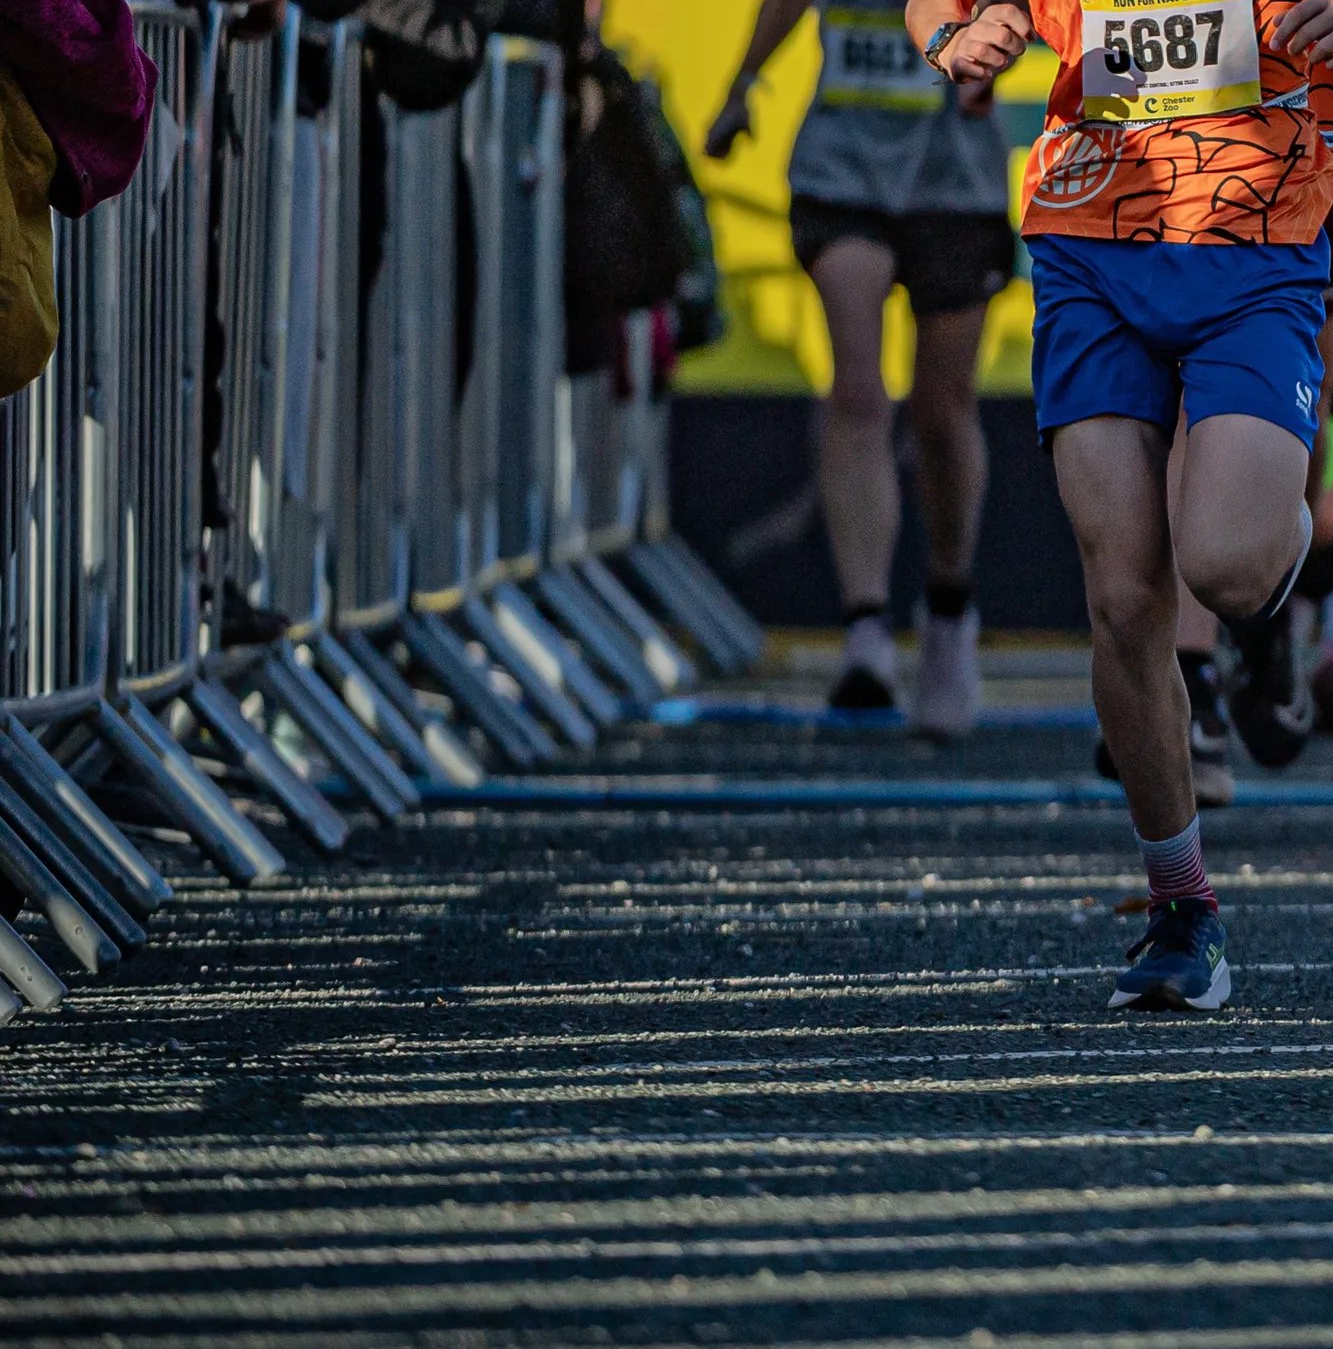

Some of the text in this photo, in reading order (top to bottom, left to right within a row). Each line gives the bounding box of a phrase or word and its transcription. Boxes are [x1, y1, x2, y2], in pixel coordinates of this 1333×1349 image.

[1104, 10, 1224, 74] 5687
[1162, 96, 1195, 105] Chester
[1163, 104, 1179, 112] Zoo
